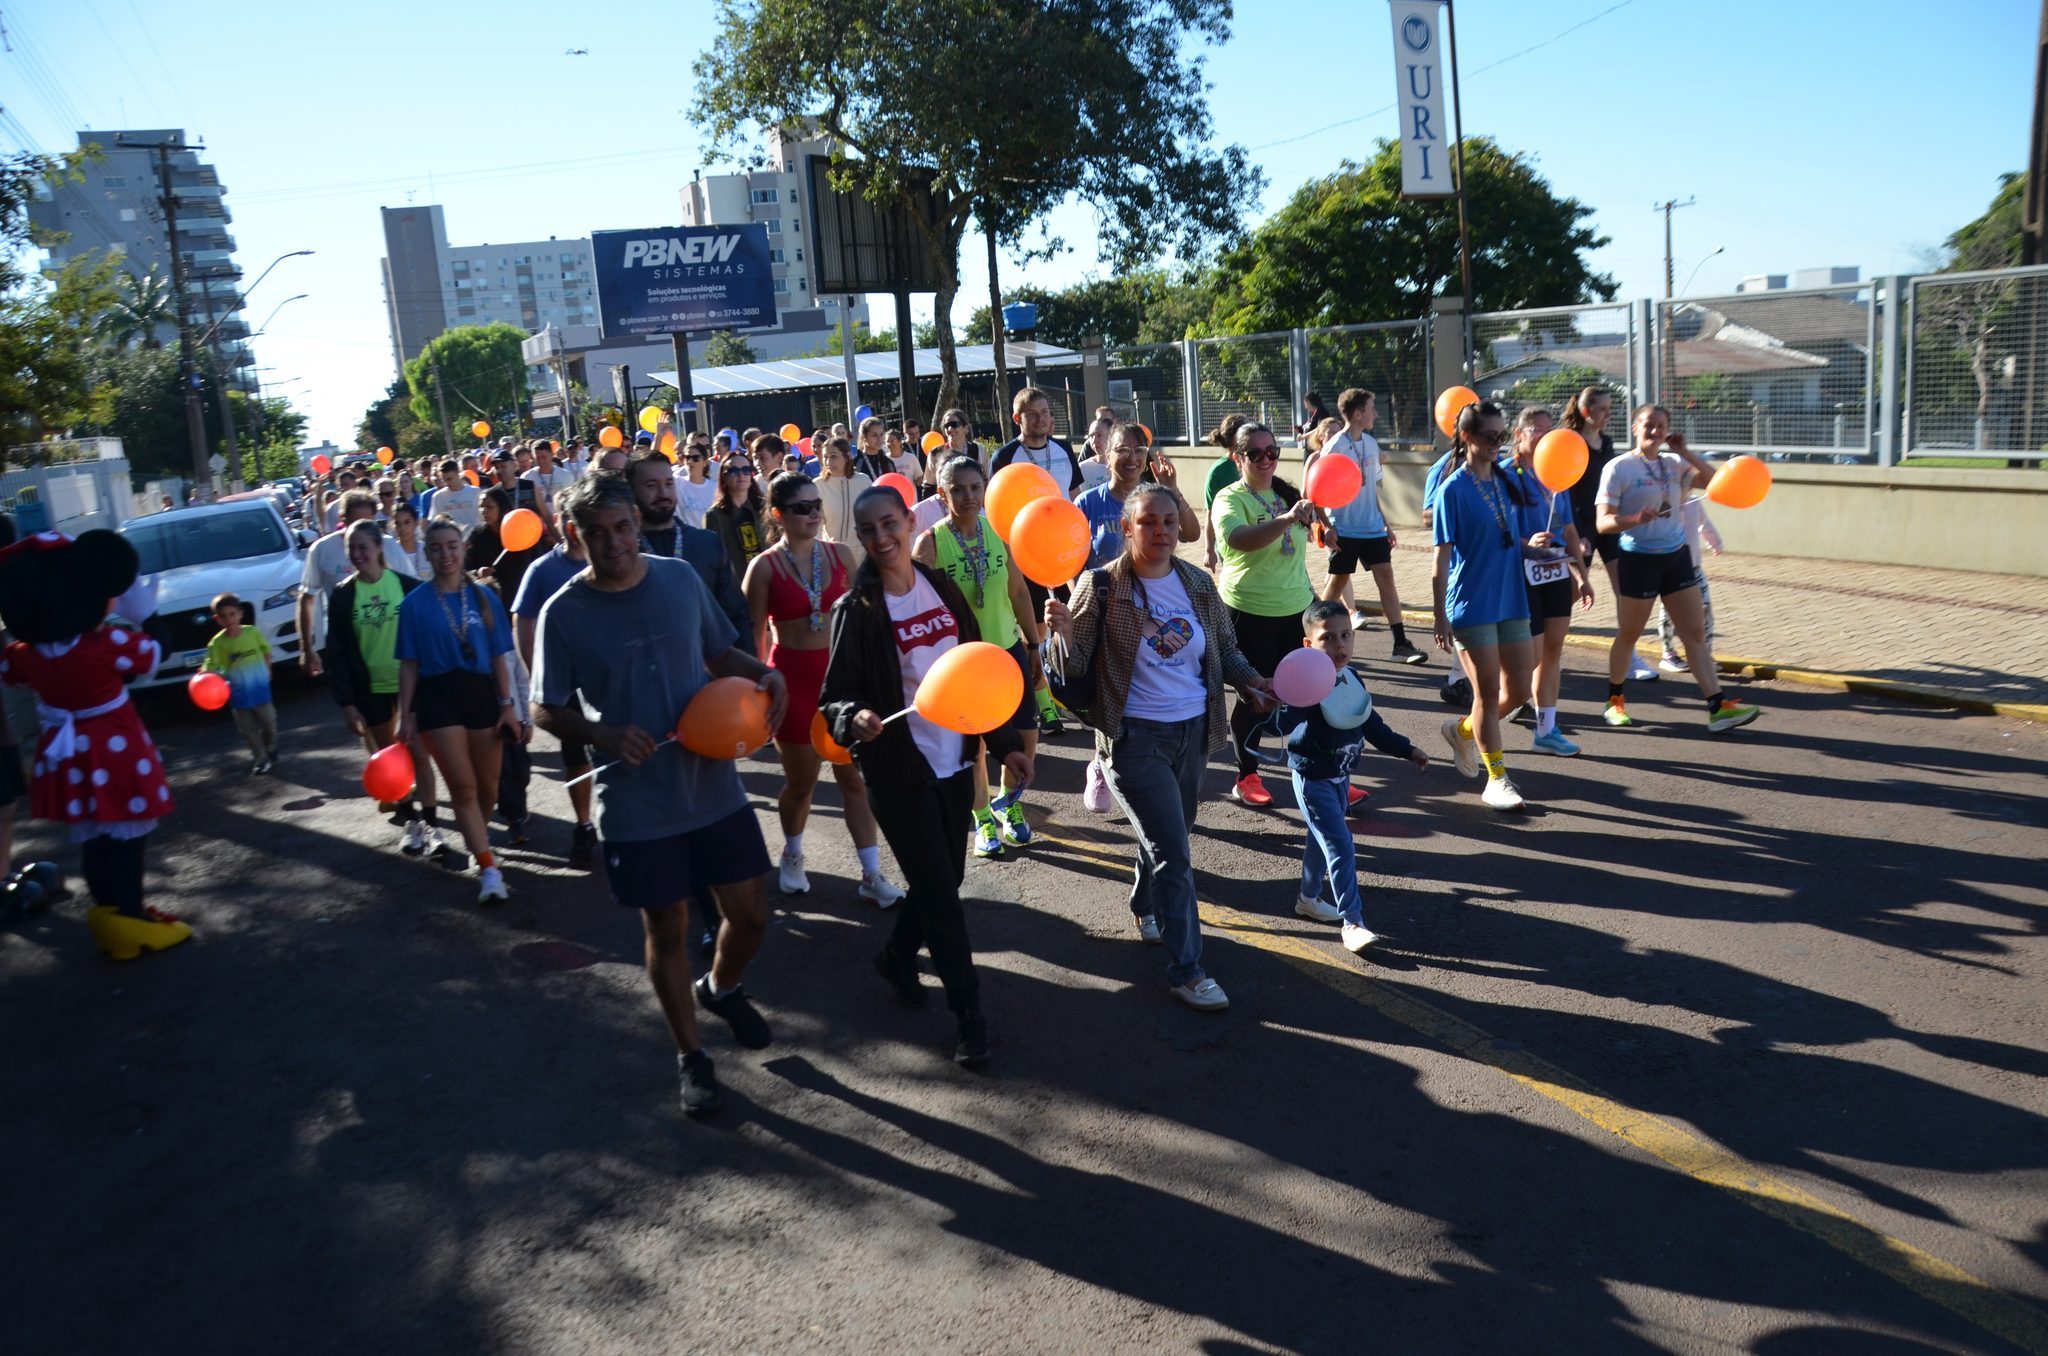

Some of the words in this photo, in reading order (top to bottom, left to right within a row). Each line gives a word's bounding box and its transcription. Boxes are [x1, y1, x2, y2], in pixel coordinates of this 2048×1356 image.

[623, 234, 741, 268] PBNEW
[653, 264, 745, 279] SISTEMAS
[647, 286, 680, 297] Soluções
[681, 284, 727, 295] tecnológicas
[661, 294, 692, 303] produtos
